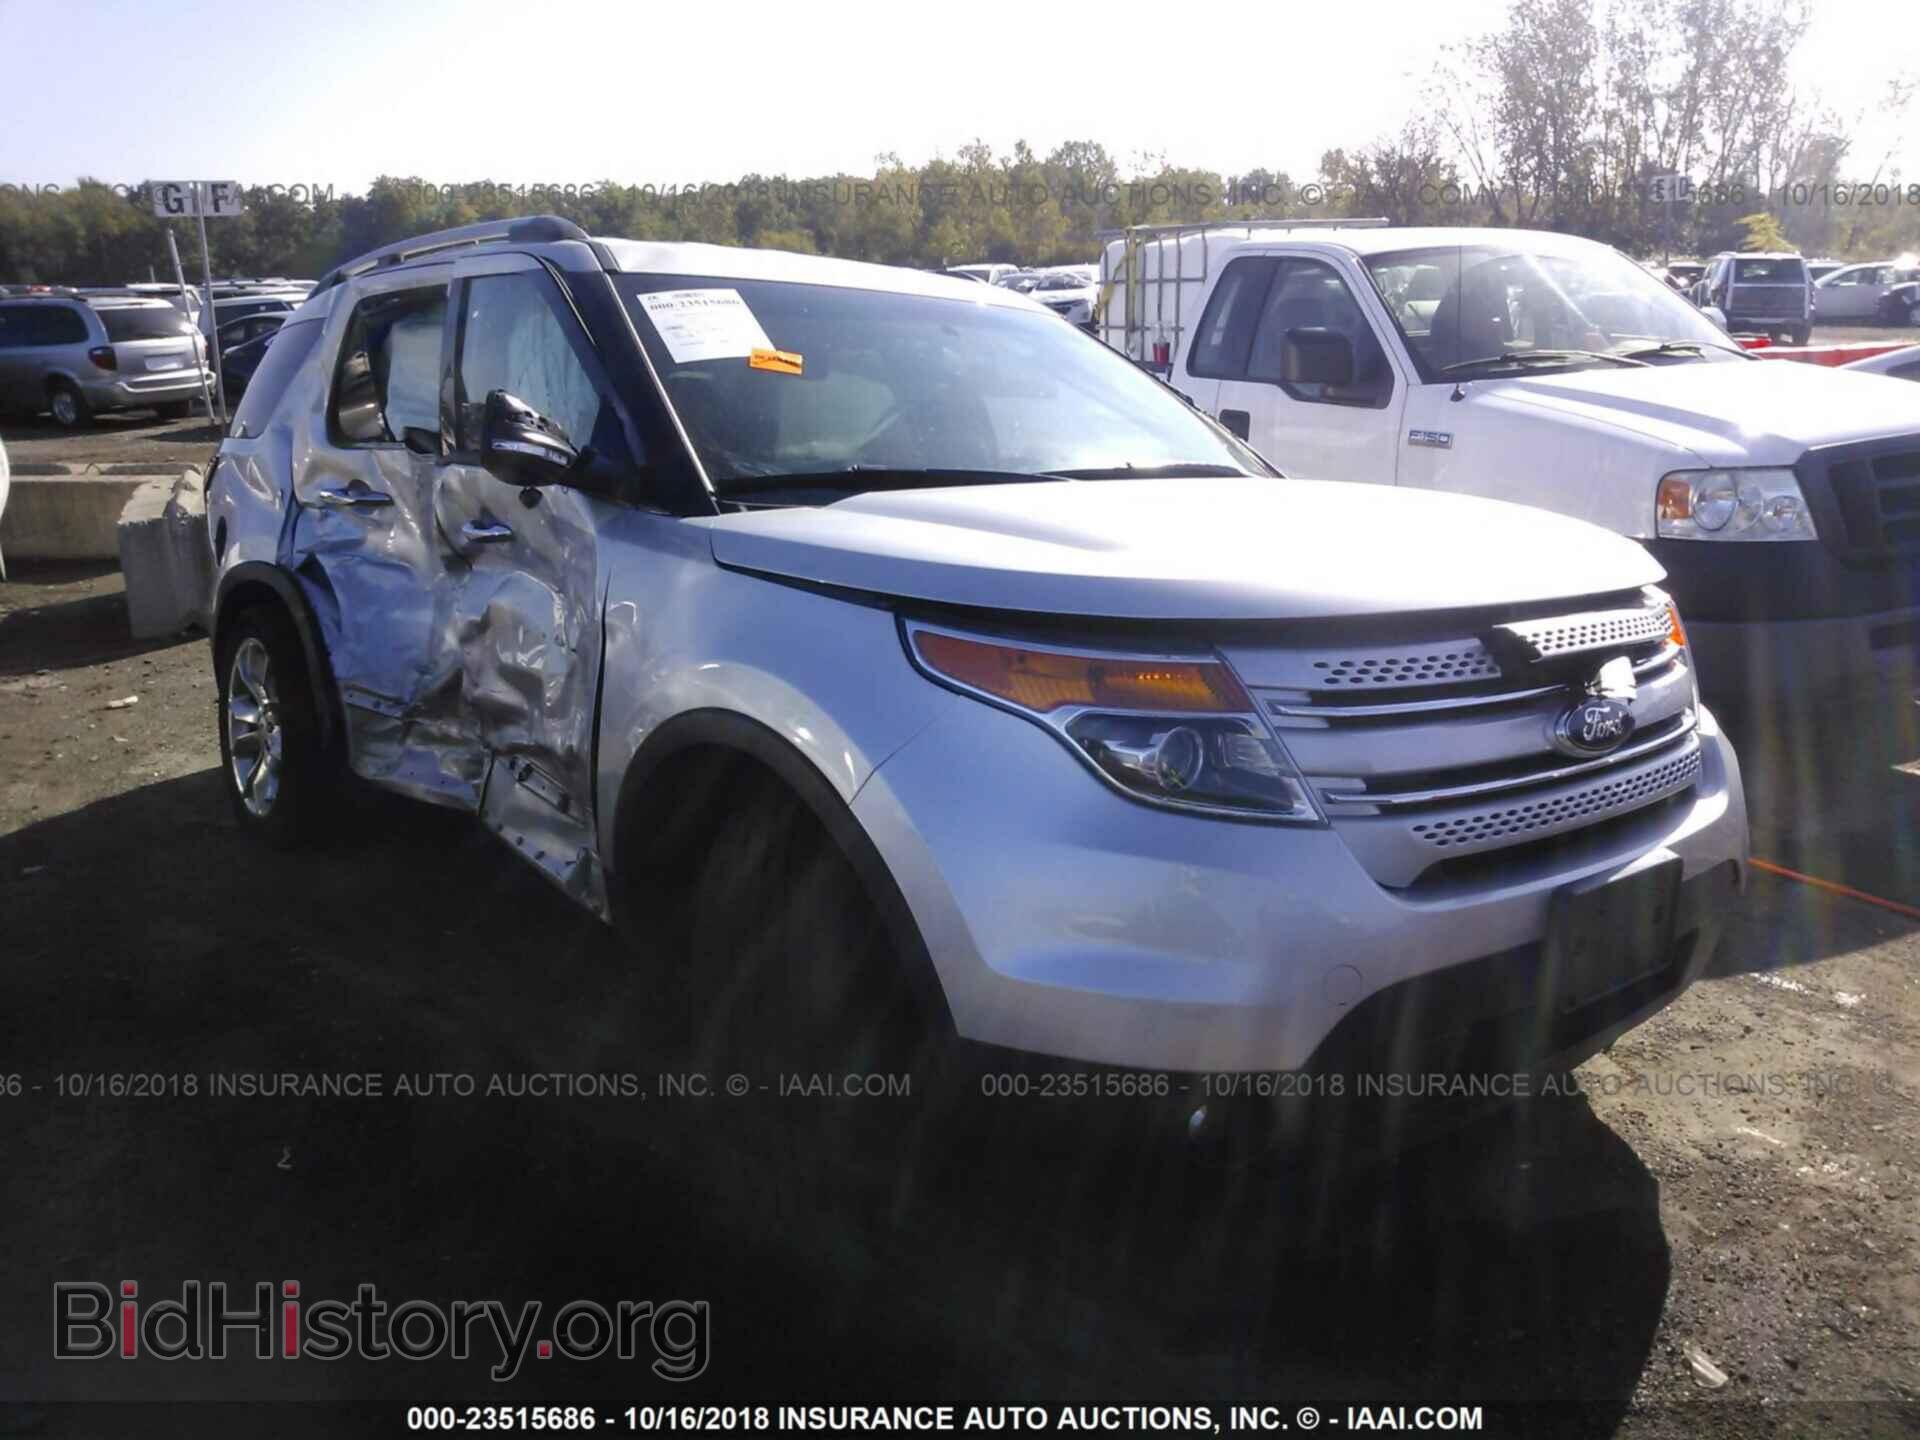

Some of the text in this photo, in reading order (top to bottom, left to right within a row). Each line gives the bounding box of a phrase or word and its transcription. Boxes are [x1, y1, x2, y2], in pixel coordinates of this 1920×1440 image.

[162, 184, 184, 214] G
[211, 184, 228, 213] F
[1583, 706, 1622, 741] Ford
